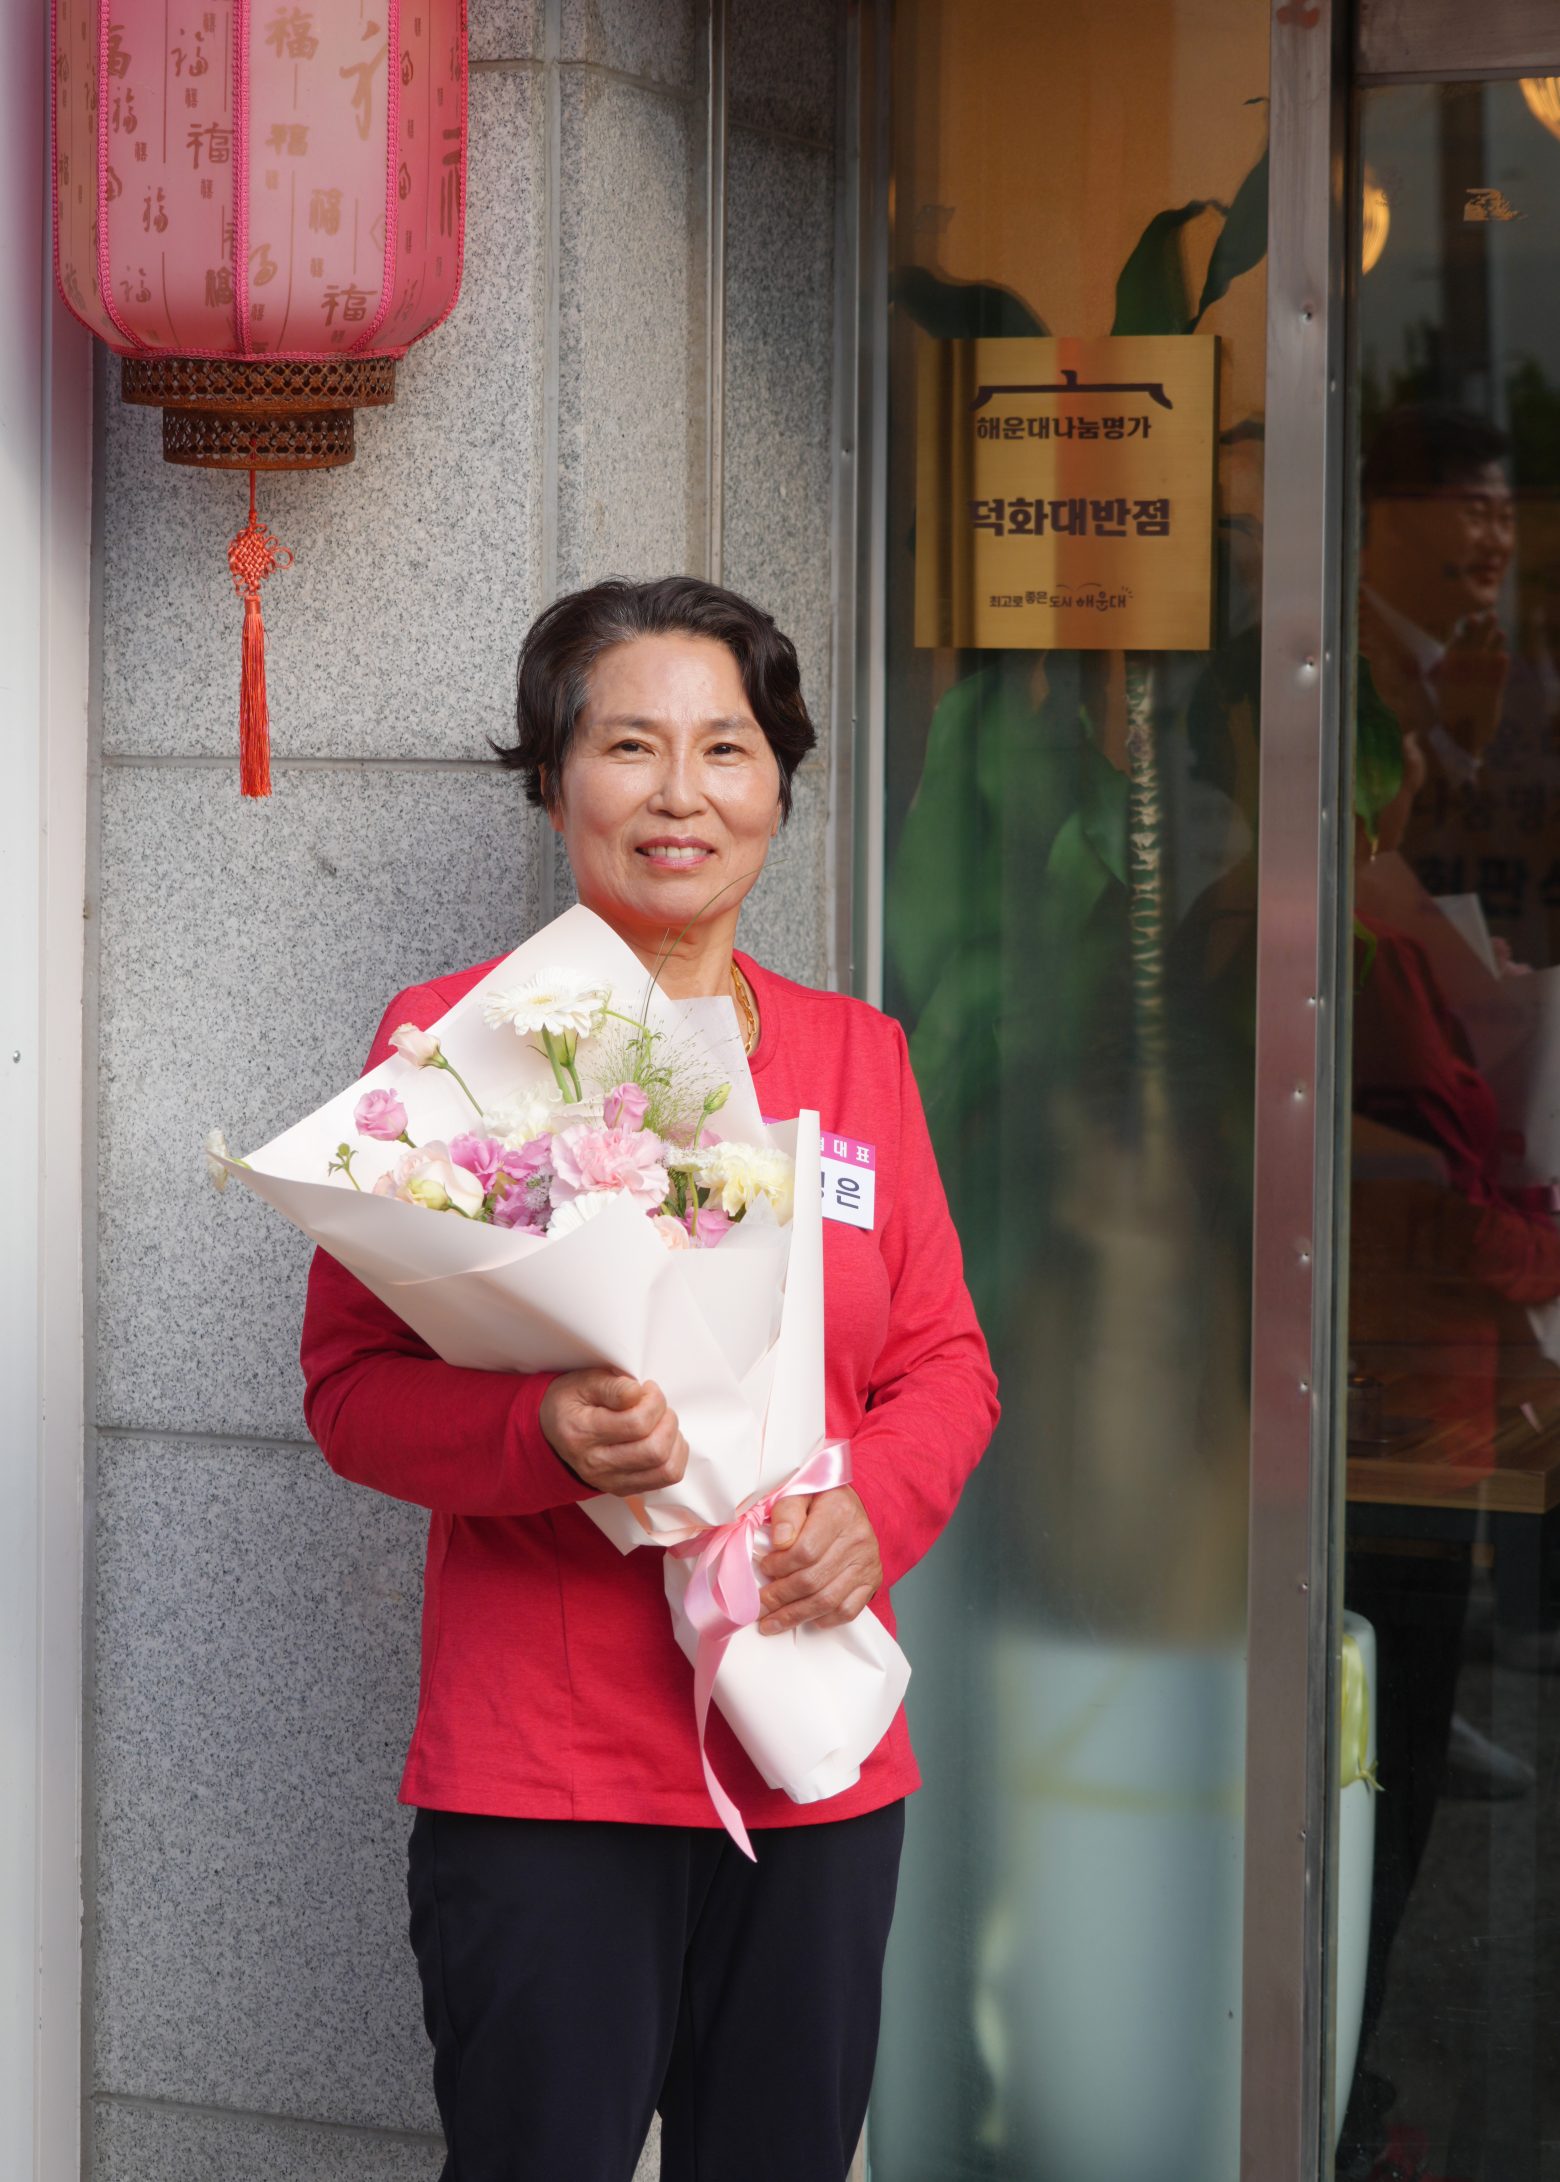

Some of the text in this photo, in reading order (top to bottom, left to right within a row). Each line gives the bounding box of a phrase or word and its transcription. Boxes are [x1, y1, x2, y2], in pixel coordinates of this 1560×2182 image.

[265, 6, 319, 60] 福
[186, 121, 234, 170] 福
[321, 282, 378, 327] 福
[976, 415, 1152, 440] 해운대나눔명가
[968, 497, 1171, 537] 덕화대반점
[989, 590, 1127, 612] 최고로 좋은 도시 해운대
